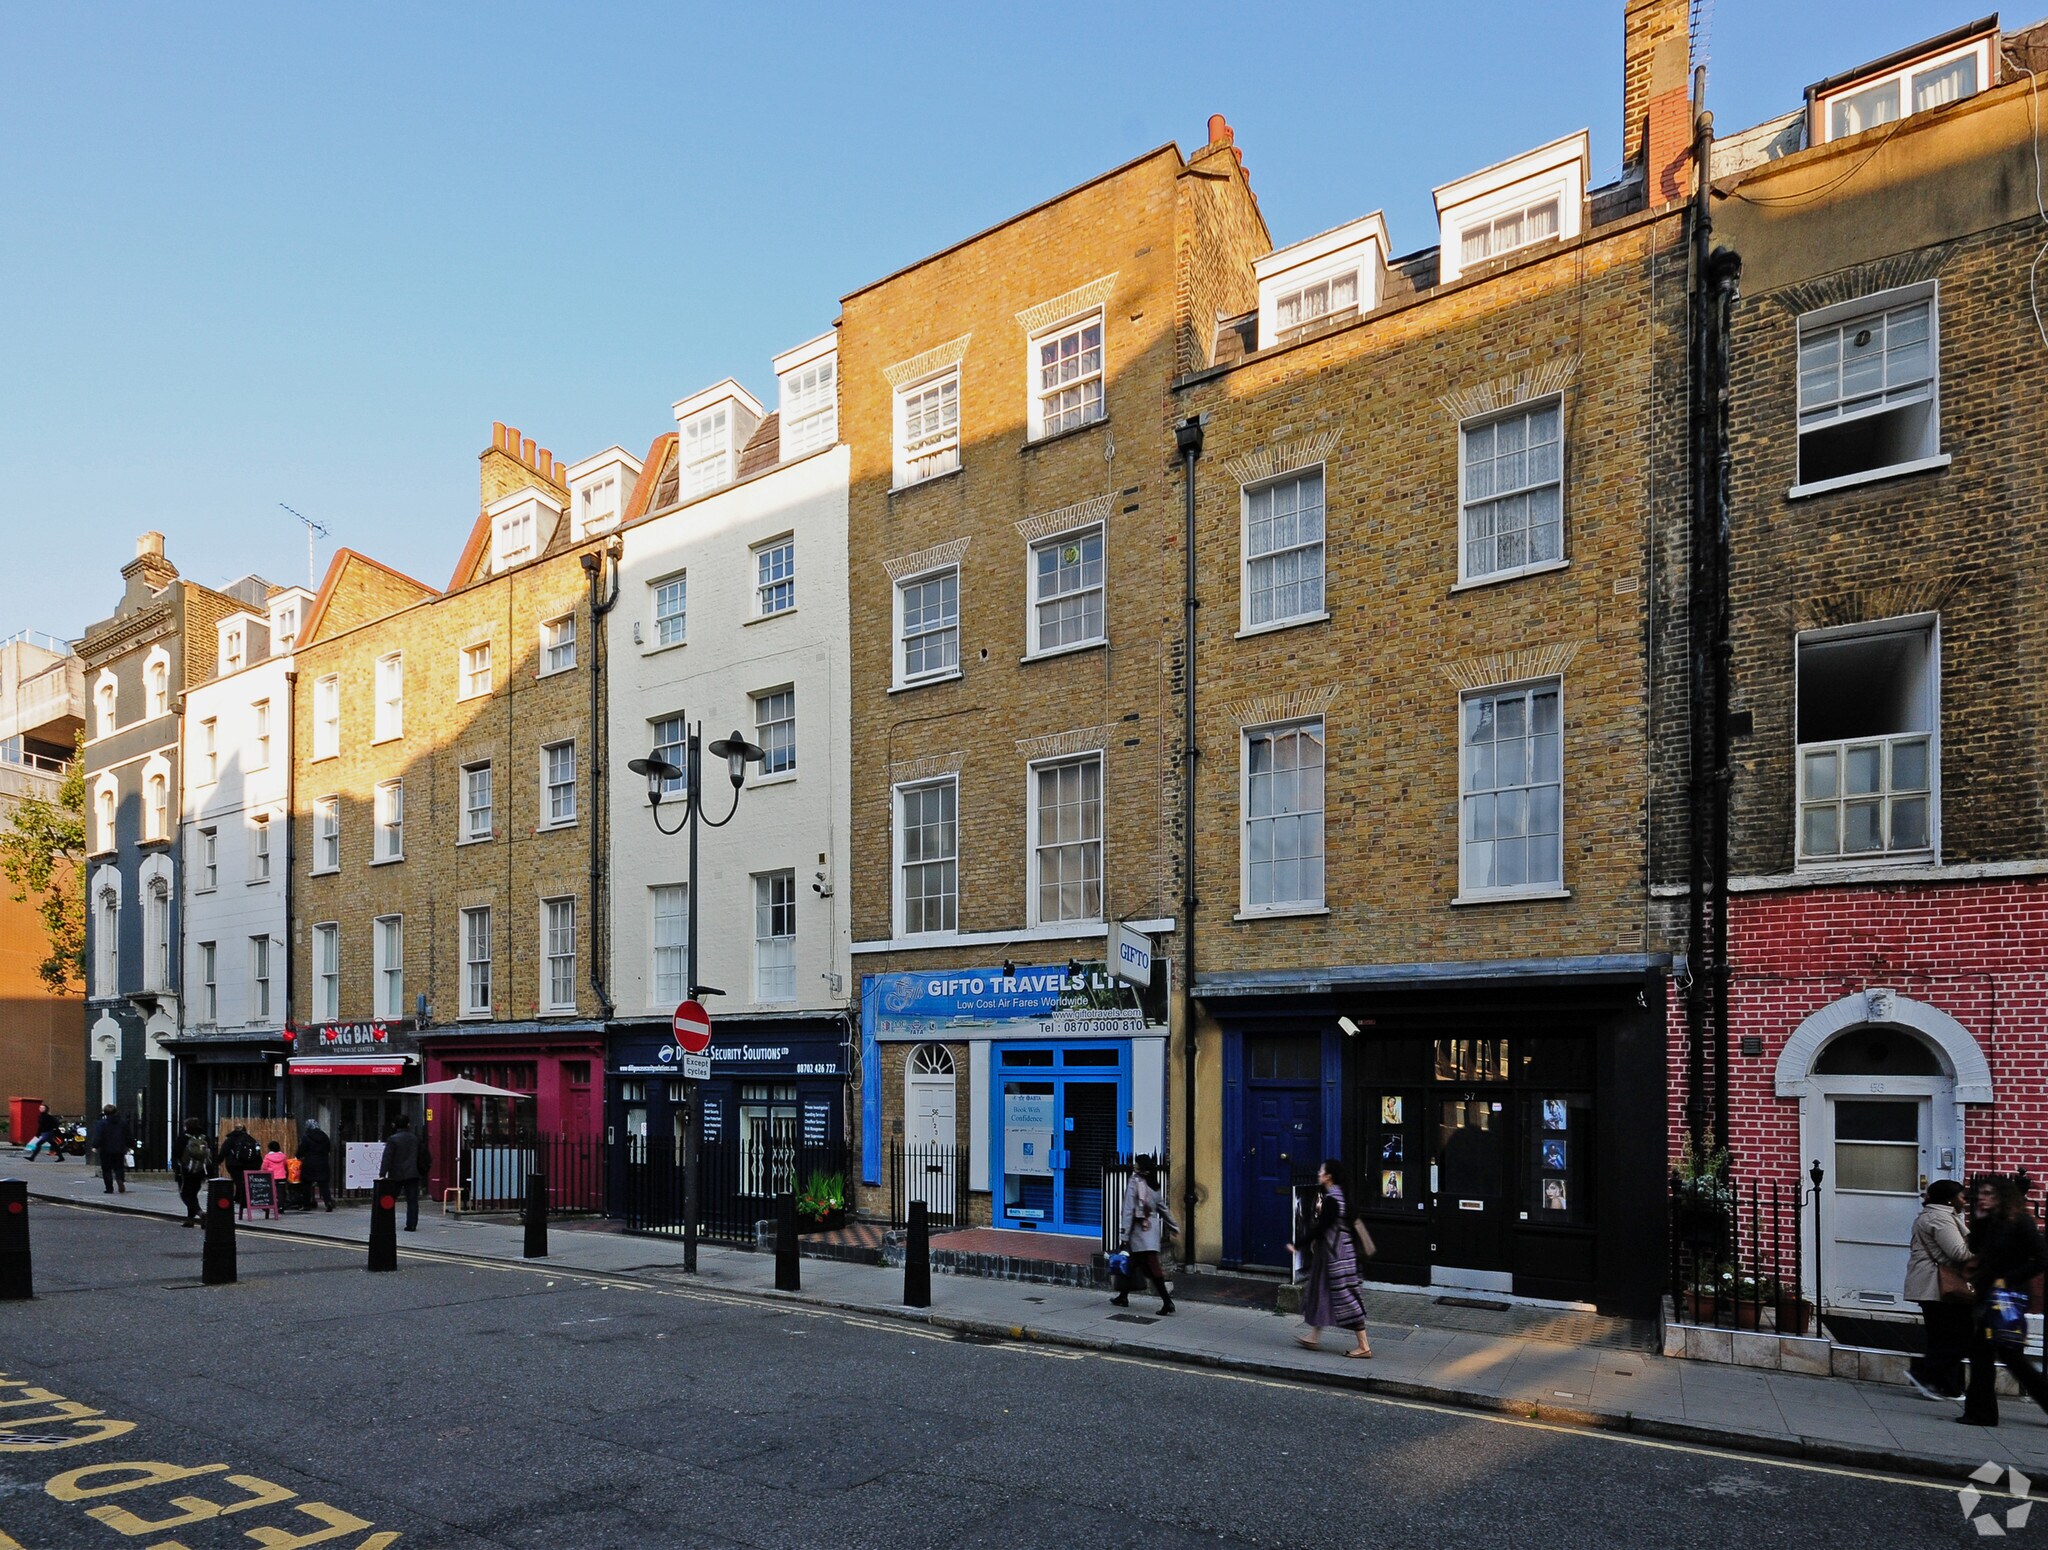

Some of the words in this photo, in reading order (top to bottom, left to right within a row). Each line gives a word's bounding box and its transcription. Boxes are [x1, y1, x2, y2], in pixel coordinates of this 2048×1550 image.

[1120, 943, 1149, 969] GIFTO
[927, 979, 985, 996] GIFTO
[990, 974, 1085, 994] TRAVELS
[956, 1000, 974, 1010] Low
[976, 999, 996, 1009] Cost
[998, 998, 1010, 1008] Air
[1014, 998, 1038, 1008] Fares
[1040, 996, 1088, 1006] Worldwide
[1052, 1008, 1142, 1020] www.giftotravels.com
[1040, 1022, 1054, 1032] Tel
[1064, 1022, 1090, 1032] 0870
[1093, 1022, 1118, 1032] 3000
[1122, 1020, 1142, 1030] 810
[710, 1046, 741, 1060] SECURITY
[743, 1045, 780, 1060] SOLUTIONS
[686, 1058, 708, 1068] Except
[826, 1064, 836, 1073] 727
[1464, 1092, 1475, 1100] 57
[44, 1461, 402, 1550] EEP
